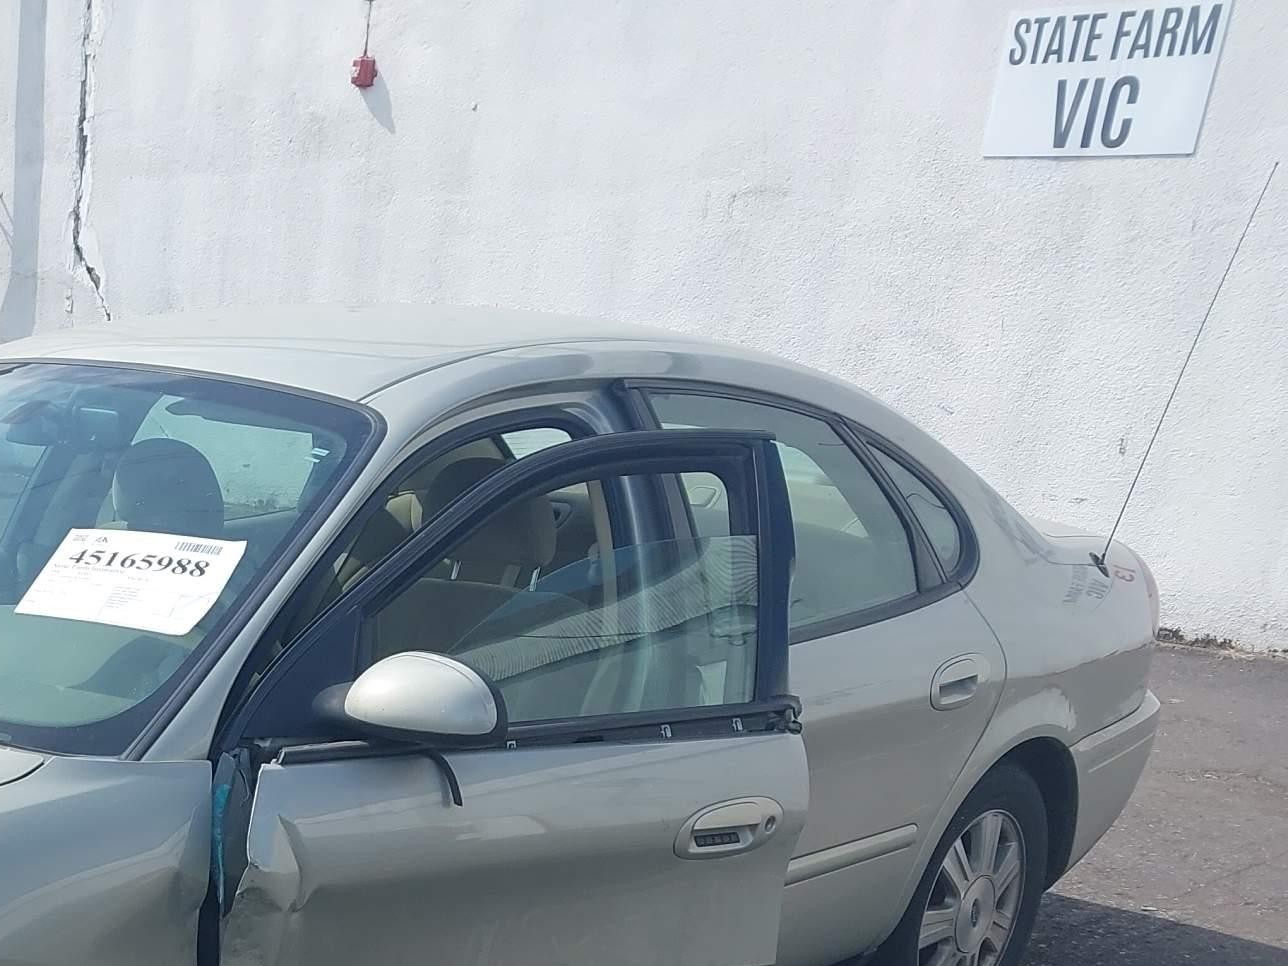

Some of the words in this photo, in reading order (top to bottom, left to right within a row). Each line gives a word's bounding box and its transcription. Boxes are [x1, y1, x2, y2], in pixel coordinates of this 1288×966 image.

[1008, 12, 1108, 66] STATE
[1110, 3, 1224, 61] FARM
[1052, 75, 1141, 149] VIC
[69, 548, 210, 578] 45165988
